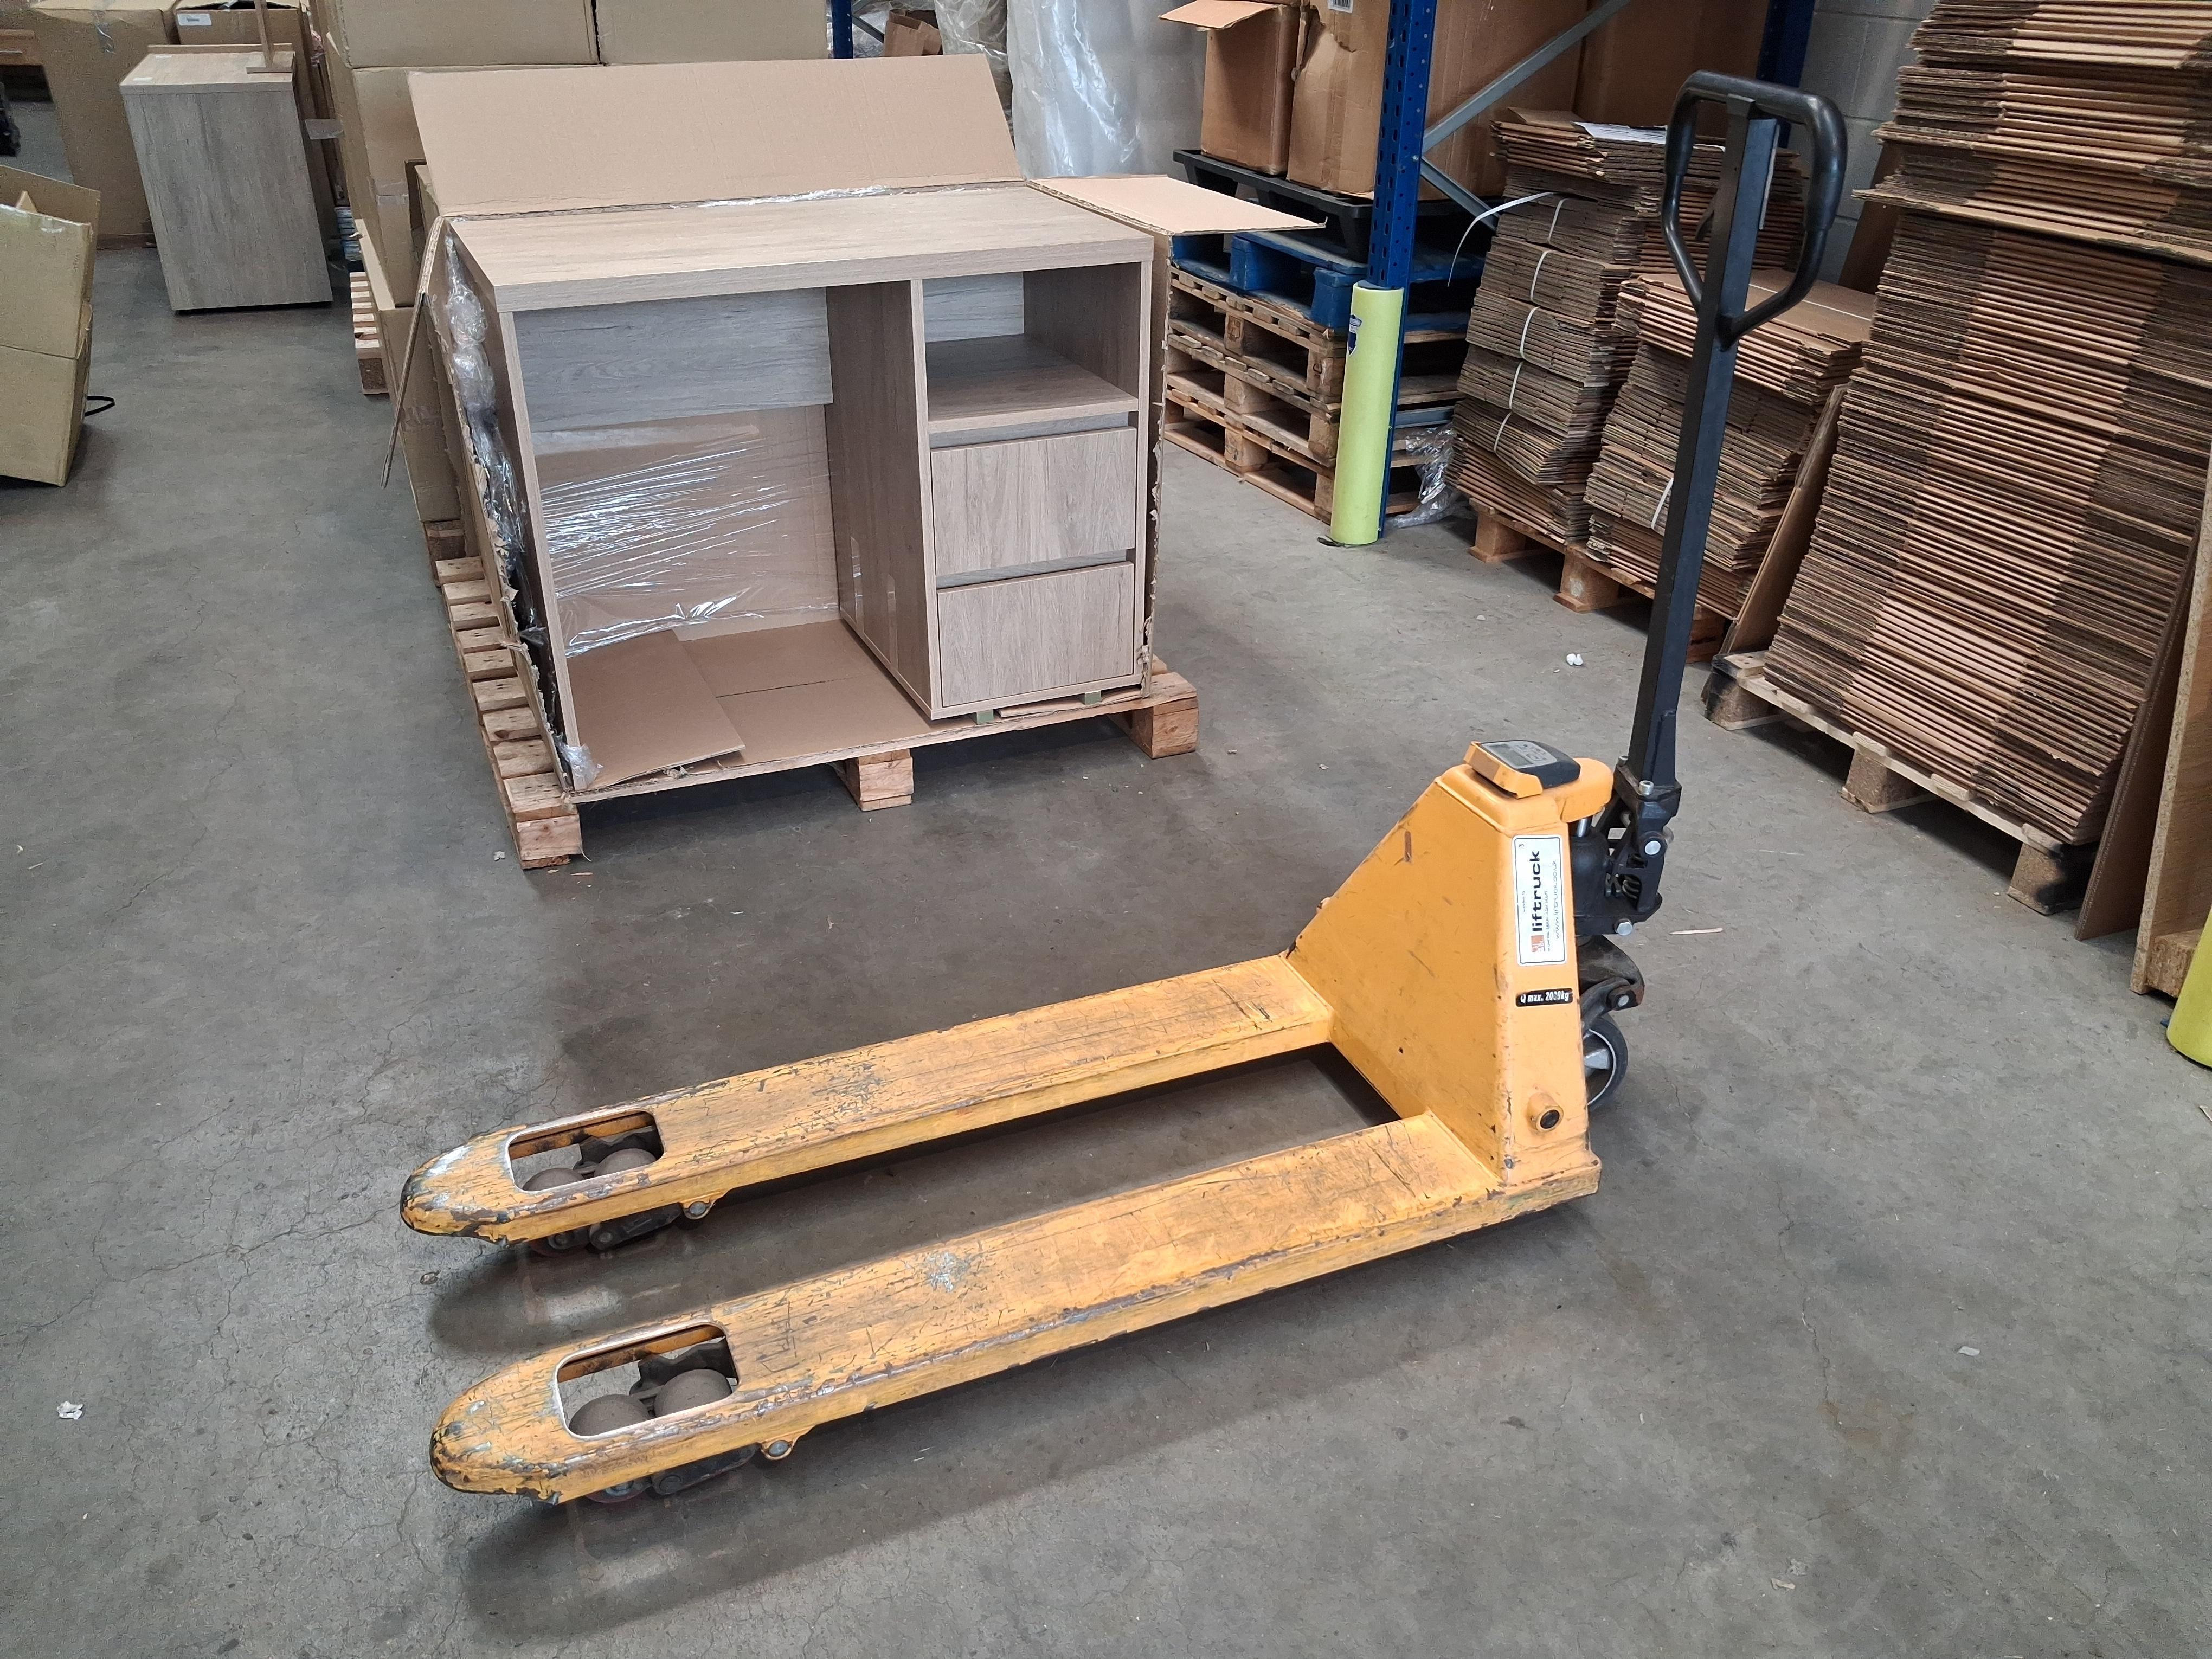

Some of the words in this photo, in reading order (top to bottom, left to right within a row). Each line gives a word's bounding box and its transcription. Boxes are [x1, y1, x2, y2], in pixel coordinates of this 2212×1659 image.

[1529, 850, 1542, 931] liftruck
[1527, 994, 1544, 1002] max.
[1545, 990, 1570, 1002] 2000kg
